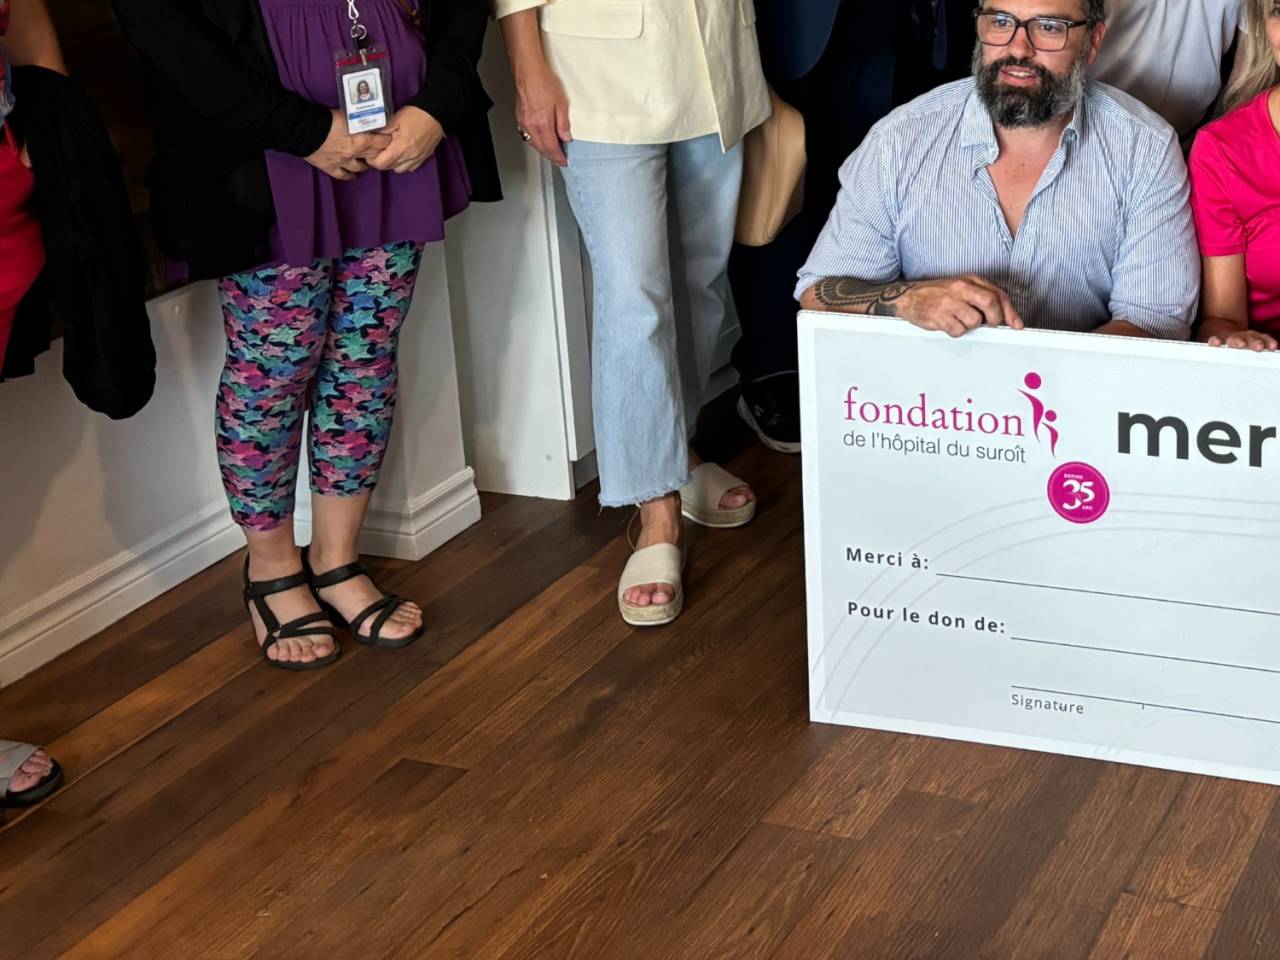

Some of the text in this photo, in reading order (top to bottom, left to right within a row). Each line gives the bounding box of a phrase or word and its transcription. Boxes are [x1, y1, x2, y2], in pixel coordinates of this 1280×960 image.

[843, 385, 1025, 437] fondation
[843, 430, 1027, 464] de l'hôpital du suroît
[1062, 479, 1096, 510] 35
[846, 547, 903, 567] Merci
[847, 601, 1006, 634] Pour le don de:
[1011, 693, 1085, 715] Signature
